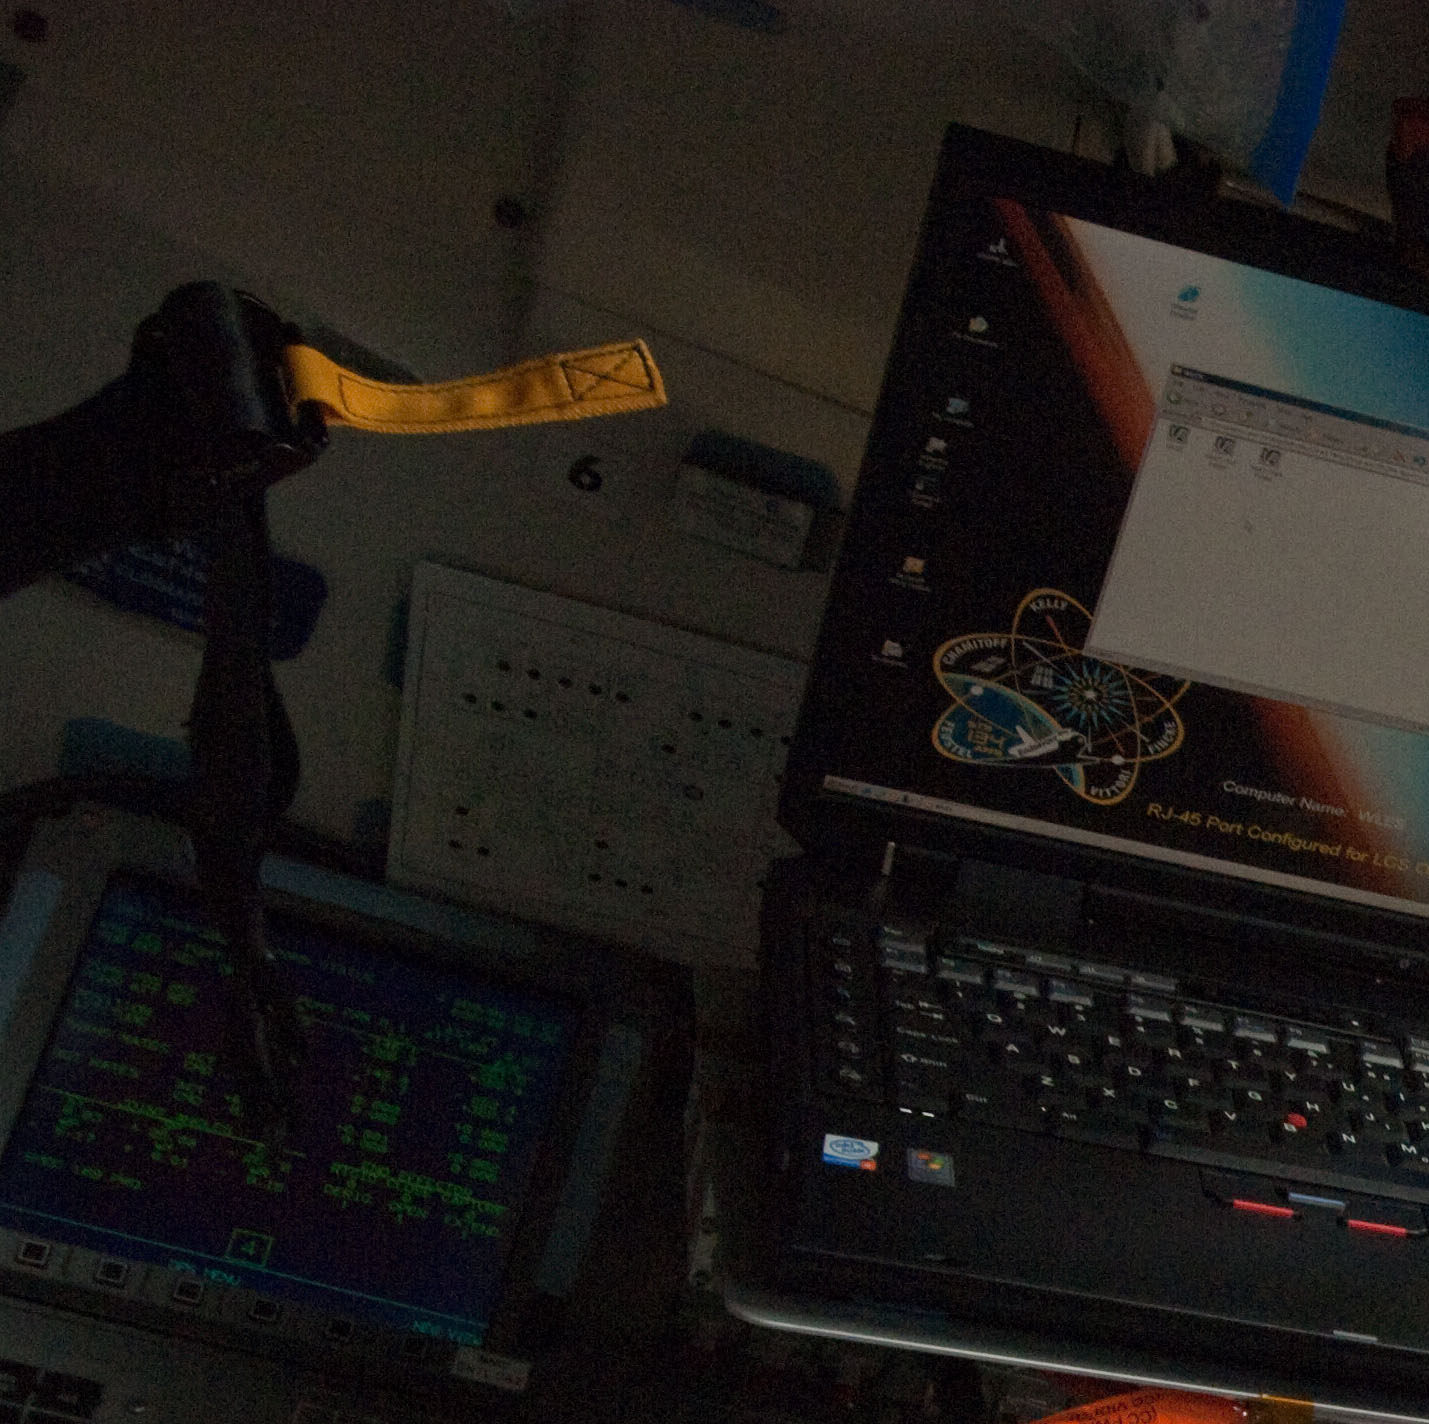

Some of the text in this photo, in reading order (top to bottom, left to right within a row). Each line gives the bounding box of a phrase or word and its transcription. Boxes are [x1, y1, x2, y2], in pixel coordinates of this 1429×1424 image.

[567, 455, 602, 492] 6
[1029, 595, 1070, 613] KELLY
[942, 636, 1008, 666] CHAMITOFF
[1222, 779, 1296, 810] Computer
[1147, 801, 1202, 827] RJ-45
[1206, 814, 1243, 835] Port
[1246, 823, 1340, 859] Configured
[1343, 845, 1368, 865] for
